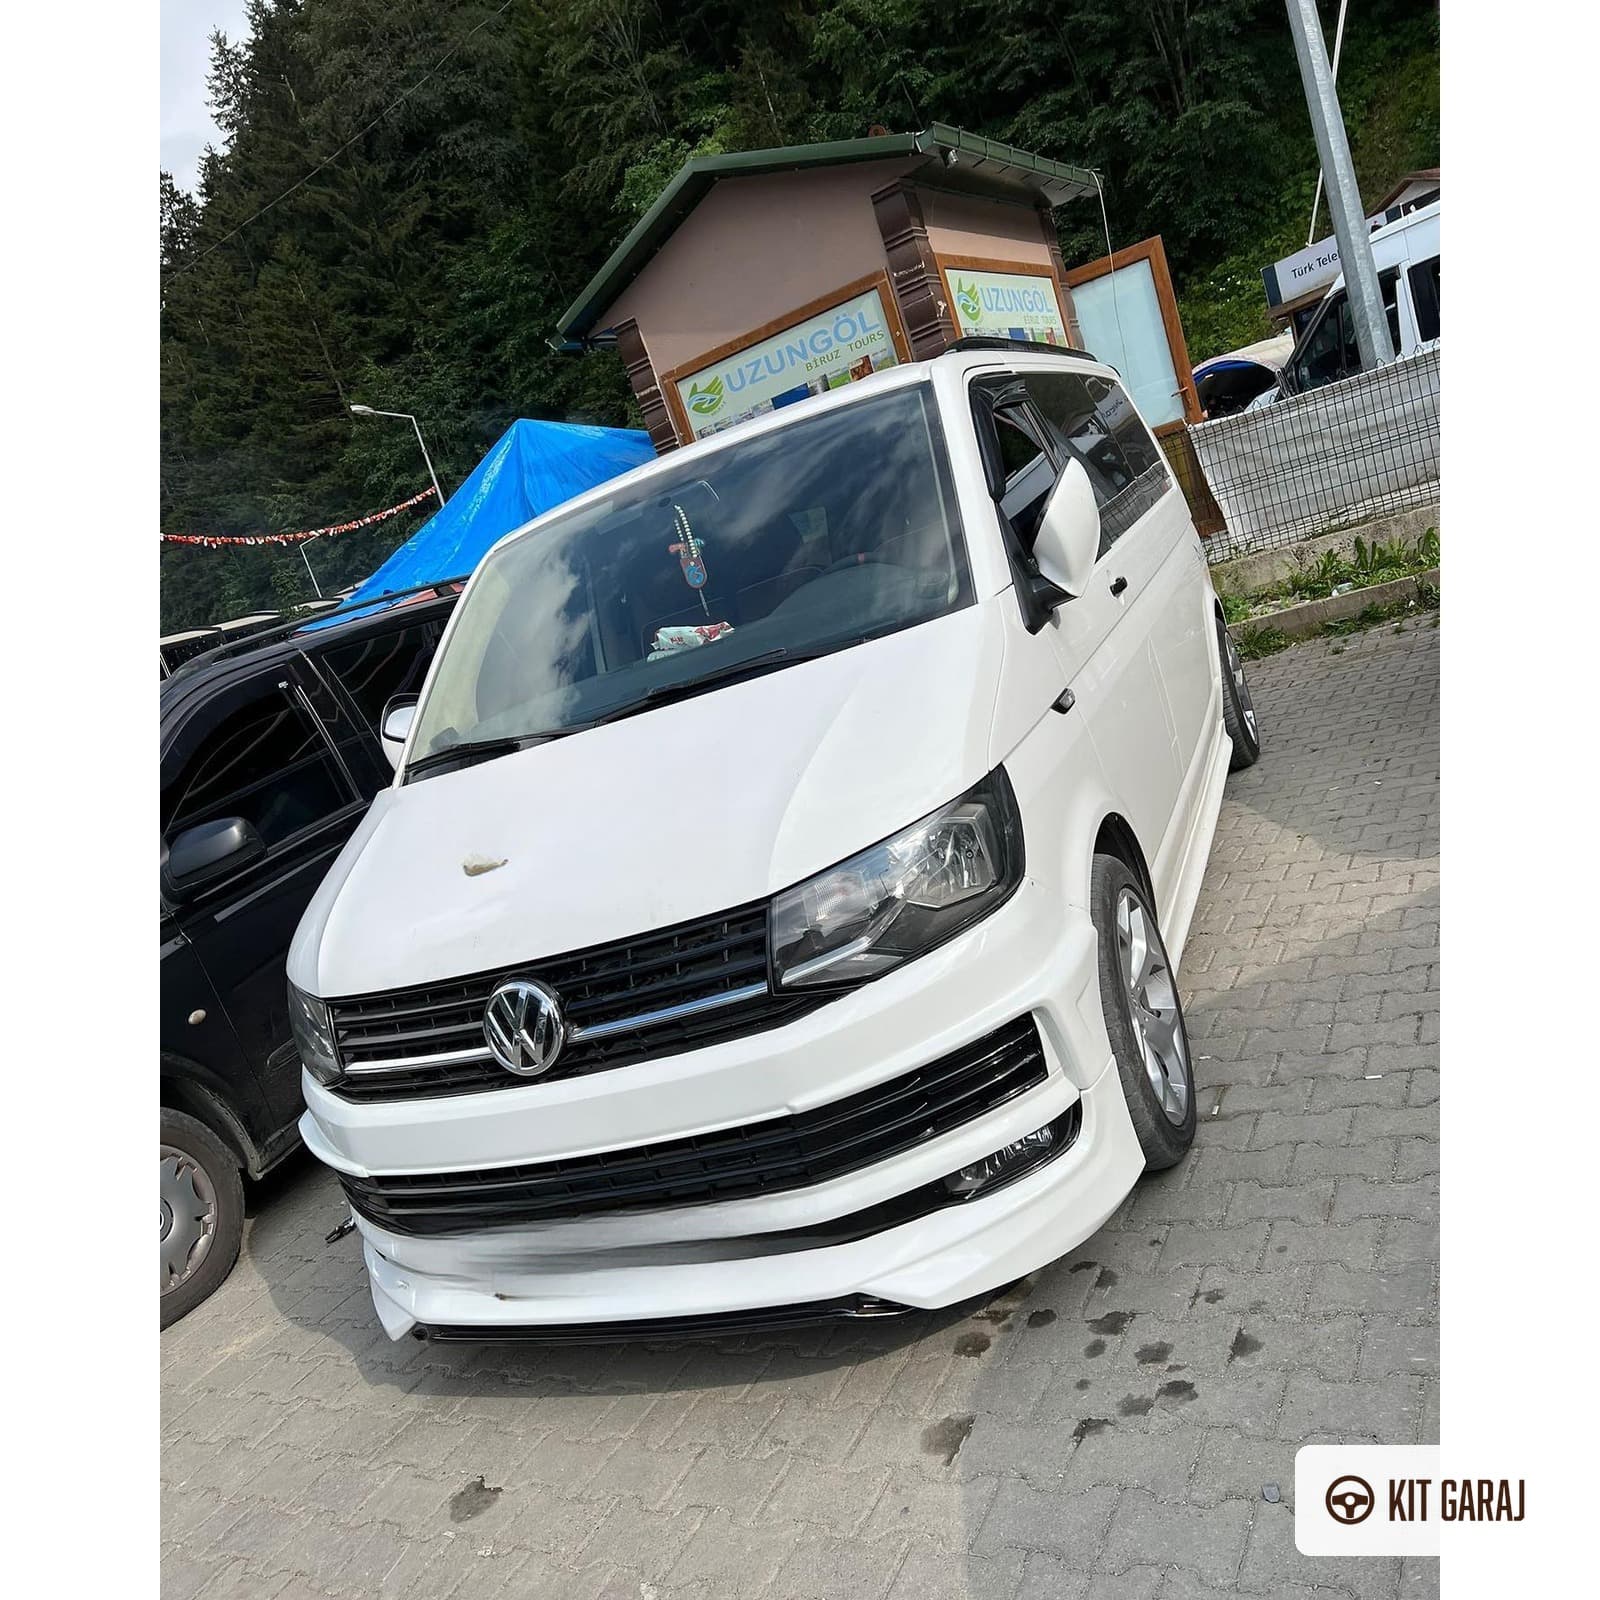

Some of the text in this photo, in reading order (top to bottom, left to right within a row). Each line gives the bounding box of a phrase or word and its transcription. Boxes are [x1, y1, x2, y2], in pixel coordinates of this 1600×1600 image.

[1291, 262, 1315, 279] Türk
[979, 284, 1055, 313] UZUNGÖL
[725, 311, 881, 393] UZUNGÖL
[805, 329, 885, 372] BİRUZ TOURS
[486, 984, 554, 1070] VW
